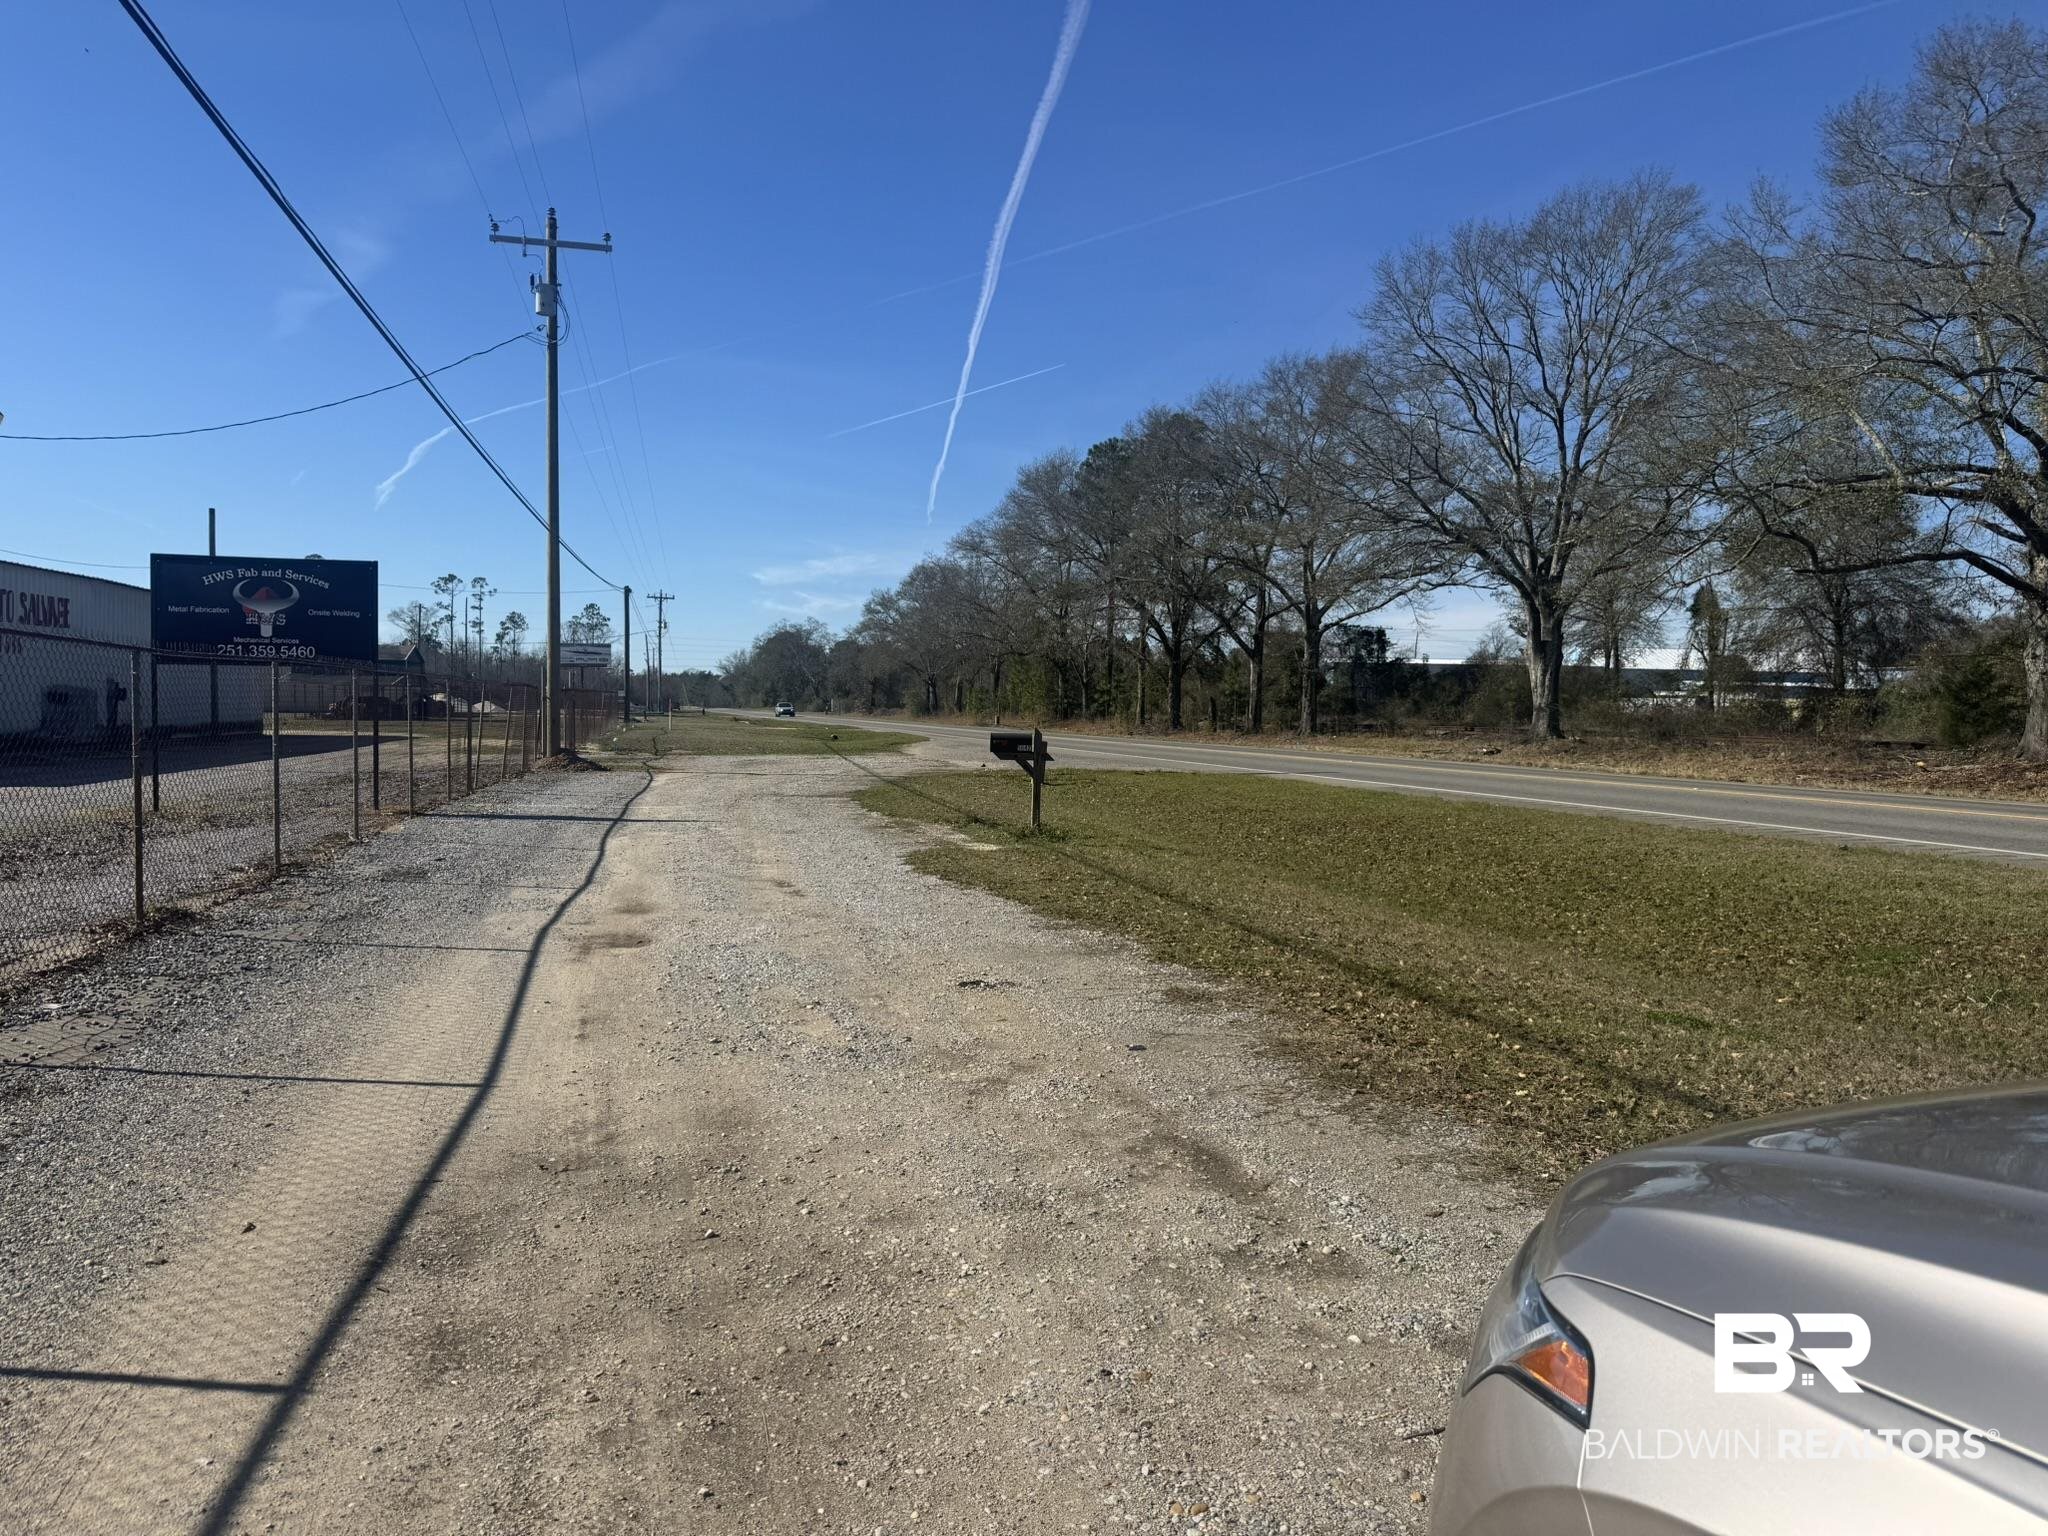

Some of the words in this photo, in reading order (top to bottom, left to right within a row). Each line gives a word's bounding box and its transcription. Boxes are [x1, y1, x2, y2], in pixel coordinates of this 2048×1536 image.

[202, 569, 234, 586] HWS
[237, 568, 259, 578] Fab
[261, 568, 282, 578] and
[284, 569, 331, 590] Services
[18, 591, 71, 629] SALVAGE
[168, 605, 189, 613] Metal
[190, 605, 230, 614] Fabrication
[308, 609, 331, 617] Onsite
[333, 609, 361, 618] Welding
[217, 644, 316, 659] 251.359.5460
